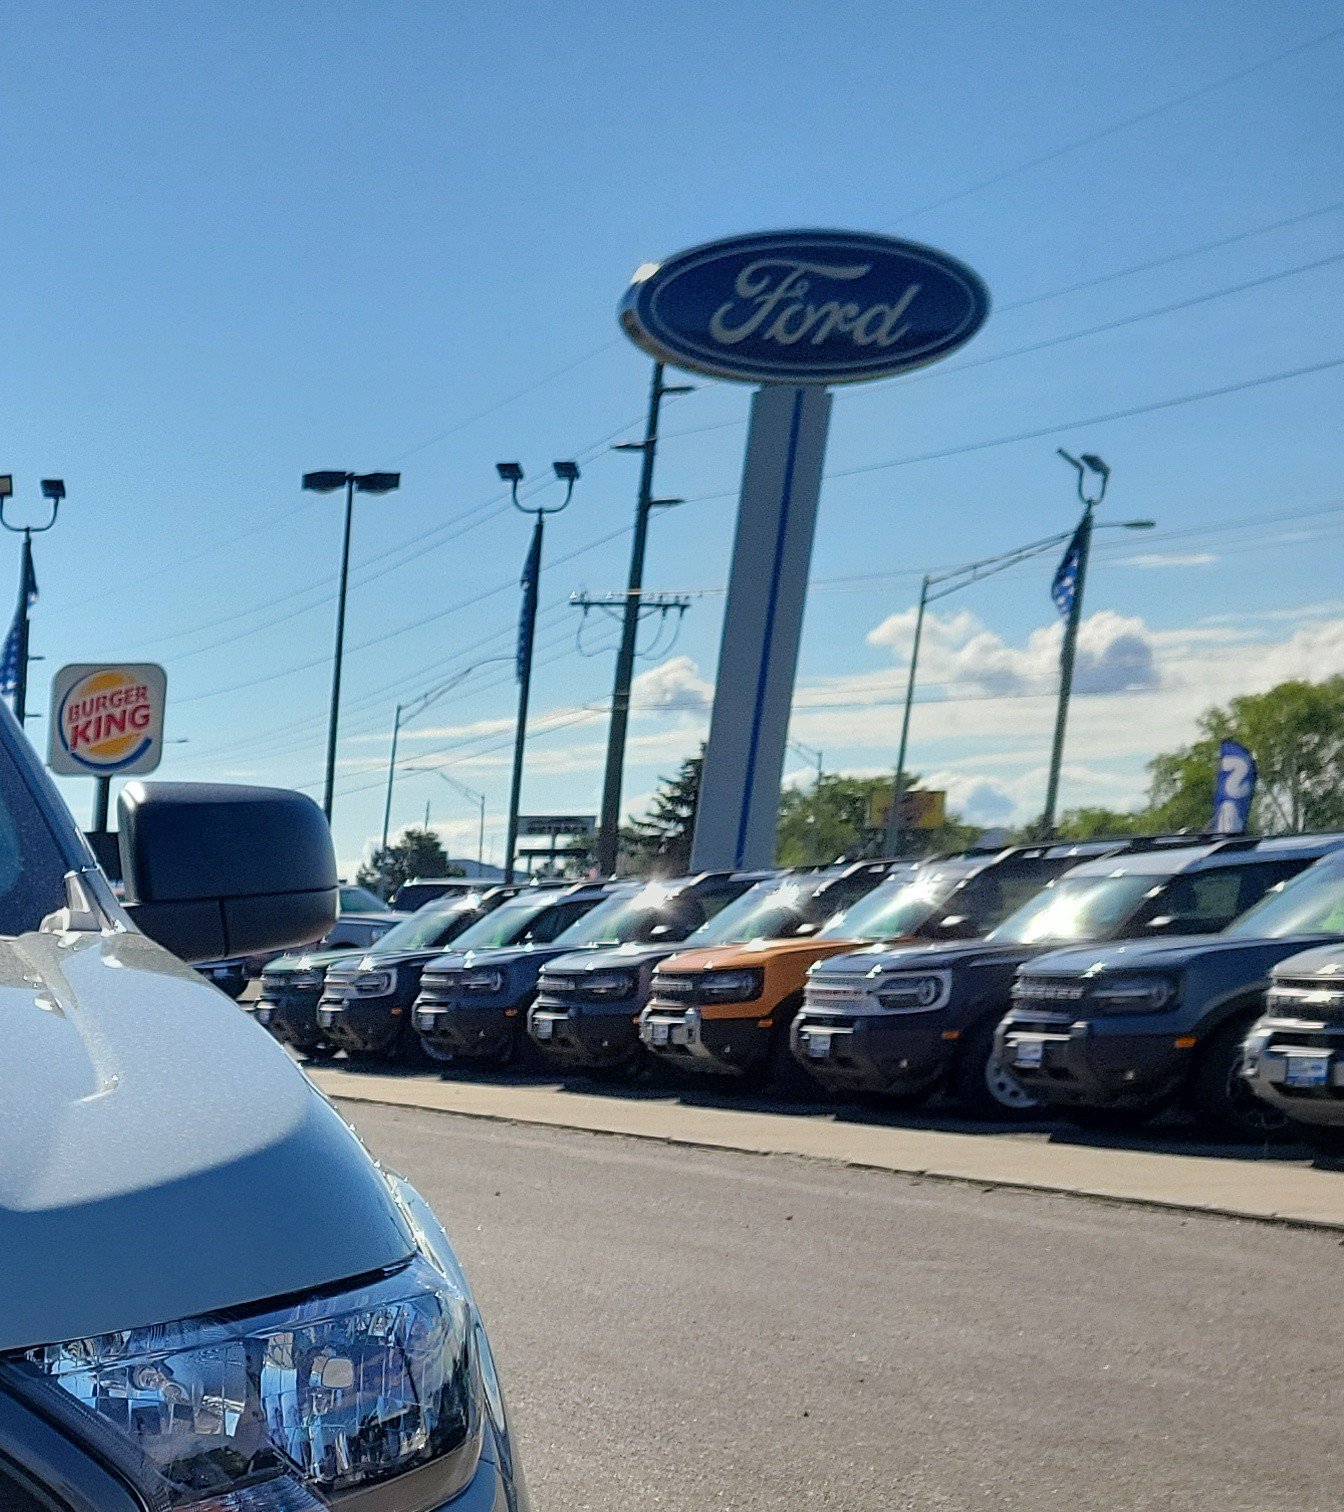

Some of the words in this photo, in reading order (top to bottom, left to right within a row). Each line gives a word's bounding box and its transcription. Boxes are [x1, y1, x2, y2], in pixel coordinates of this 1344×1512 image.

[709, 257, 921, 348] Ford
[67, 686, 148, 724] BURGER
[70, 704, 150, 750] KING
